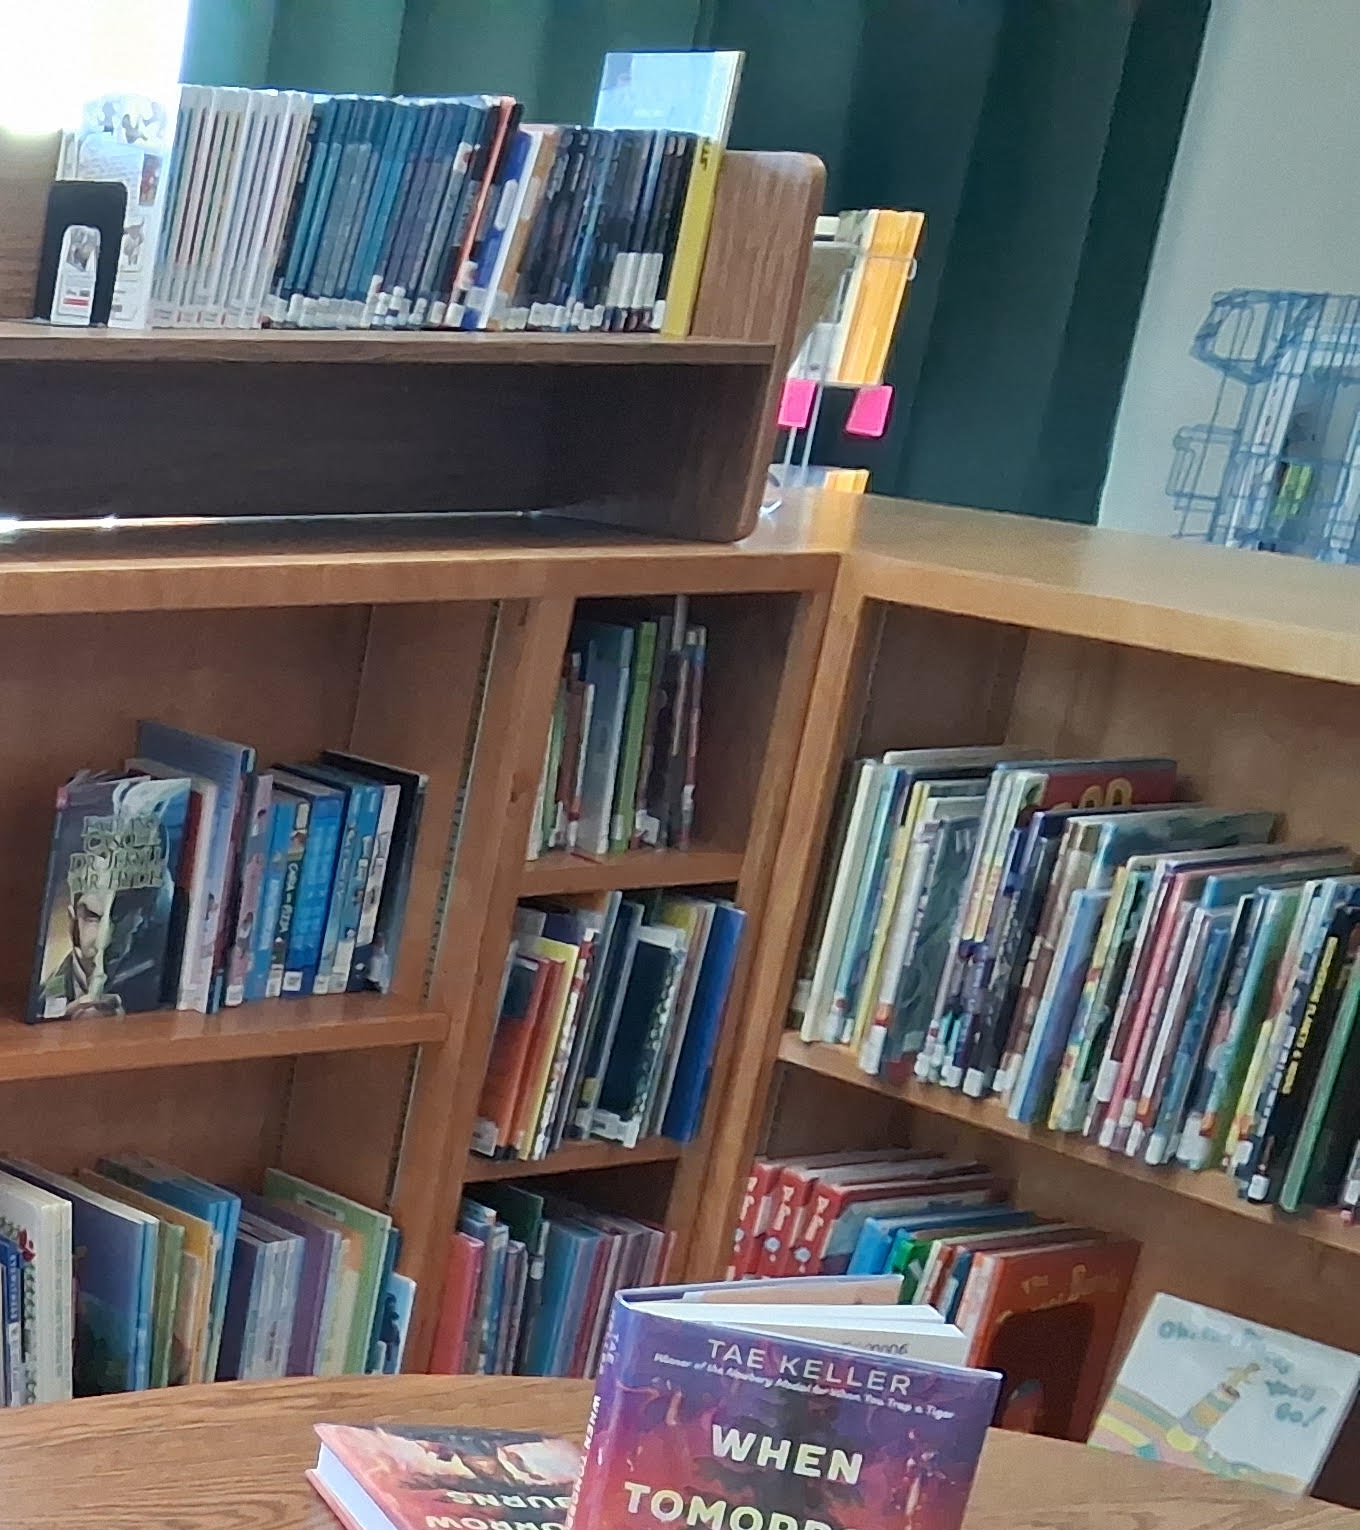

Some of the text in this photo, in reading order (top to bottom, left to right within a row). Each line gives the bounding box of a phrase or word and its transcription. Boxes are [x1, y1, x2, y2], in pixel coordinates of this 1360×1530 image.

[707, 1339, 912, 1396] TAE KELLER
[710, 1423, 865, 1486] WHEN
